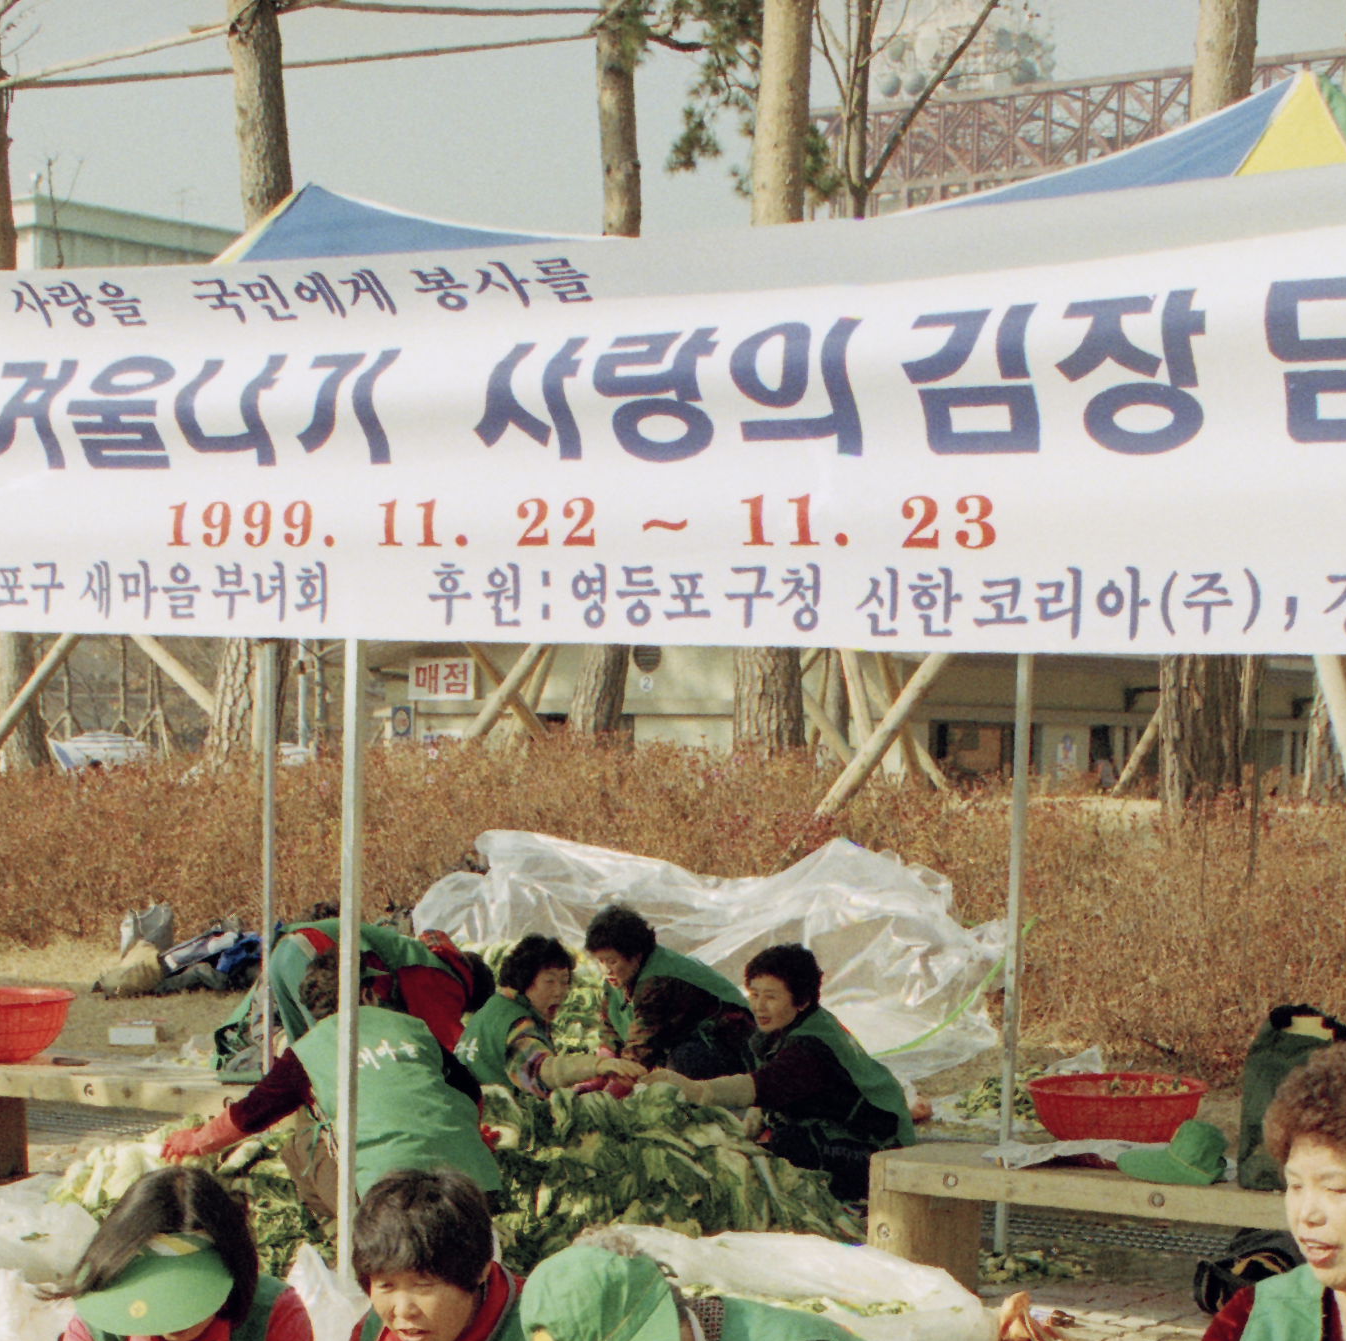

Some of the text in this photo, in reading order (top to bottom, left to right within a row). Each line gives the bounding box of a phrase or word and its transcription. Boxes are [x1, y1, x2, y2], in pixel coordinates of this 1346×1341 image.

[11, 280, 148, 328] 사랑을
[190, 267, 397, 324] 국민에게
[410, 257, 594, 312] 봉사를
[474, 317, 864, 461] 사랑의
[901, 290, 1207, 455] 김장
[166, 500, 336, 549] 1999.
[377, 498, 469, 548] 11.
[515, 496, 598, 549] 22
[739, 492, 850, 548] 11.
[901, 494, 998, 550] 23
[81, 560, 201, 619] 새마을
[211, 561, 328, 623] 부녀회
[427, 562, 551, 627] 후원:
[570, 562, 822, 632] 영등포구청
[415, 663, 468, 695] 매점
